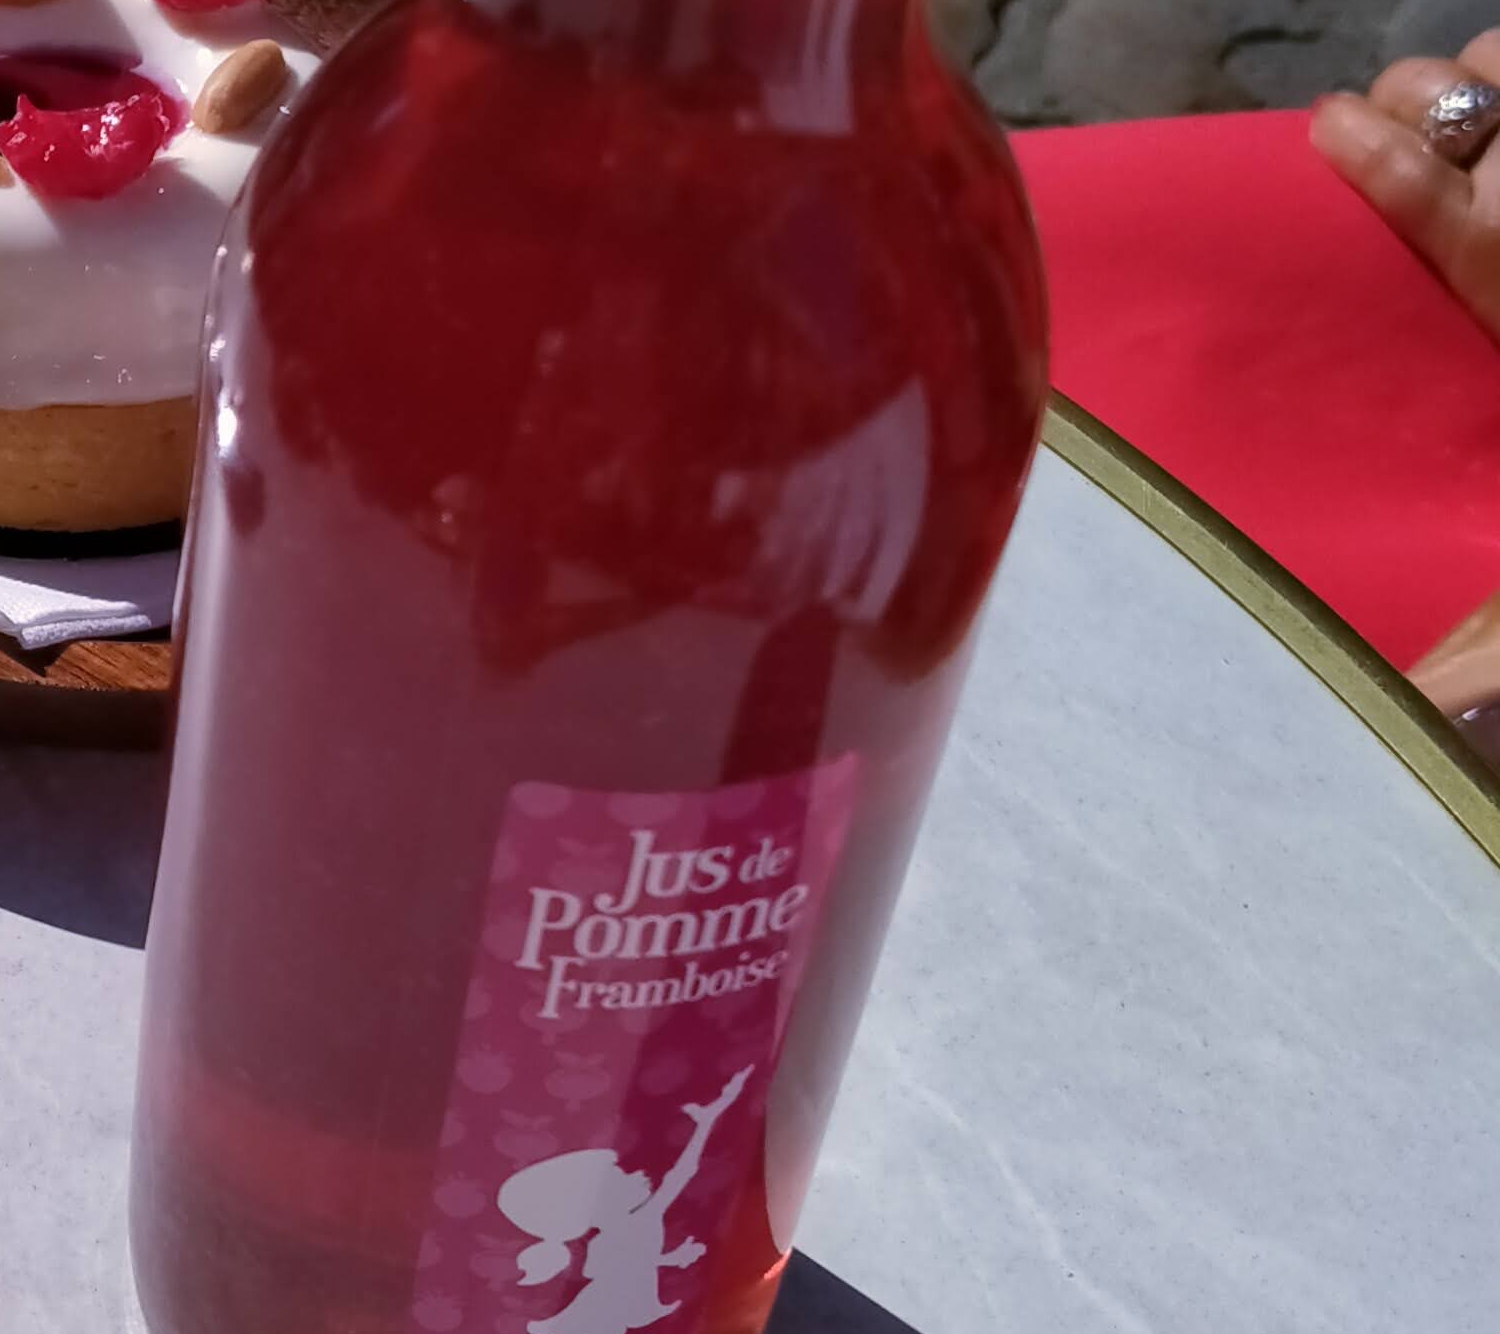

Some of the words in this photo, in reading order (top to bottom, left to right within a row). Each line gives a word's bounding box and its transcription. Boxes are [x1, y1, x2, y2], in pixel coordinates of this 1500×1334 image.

[593, 829, 736, 915] Jus
[738, 836, 794, 884] de
[514, 883, 810, 971] Pomme
[537, 949, 789, 1019] Framboise
